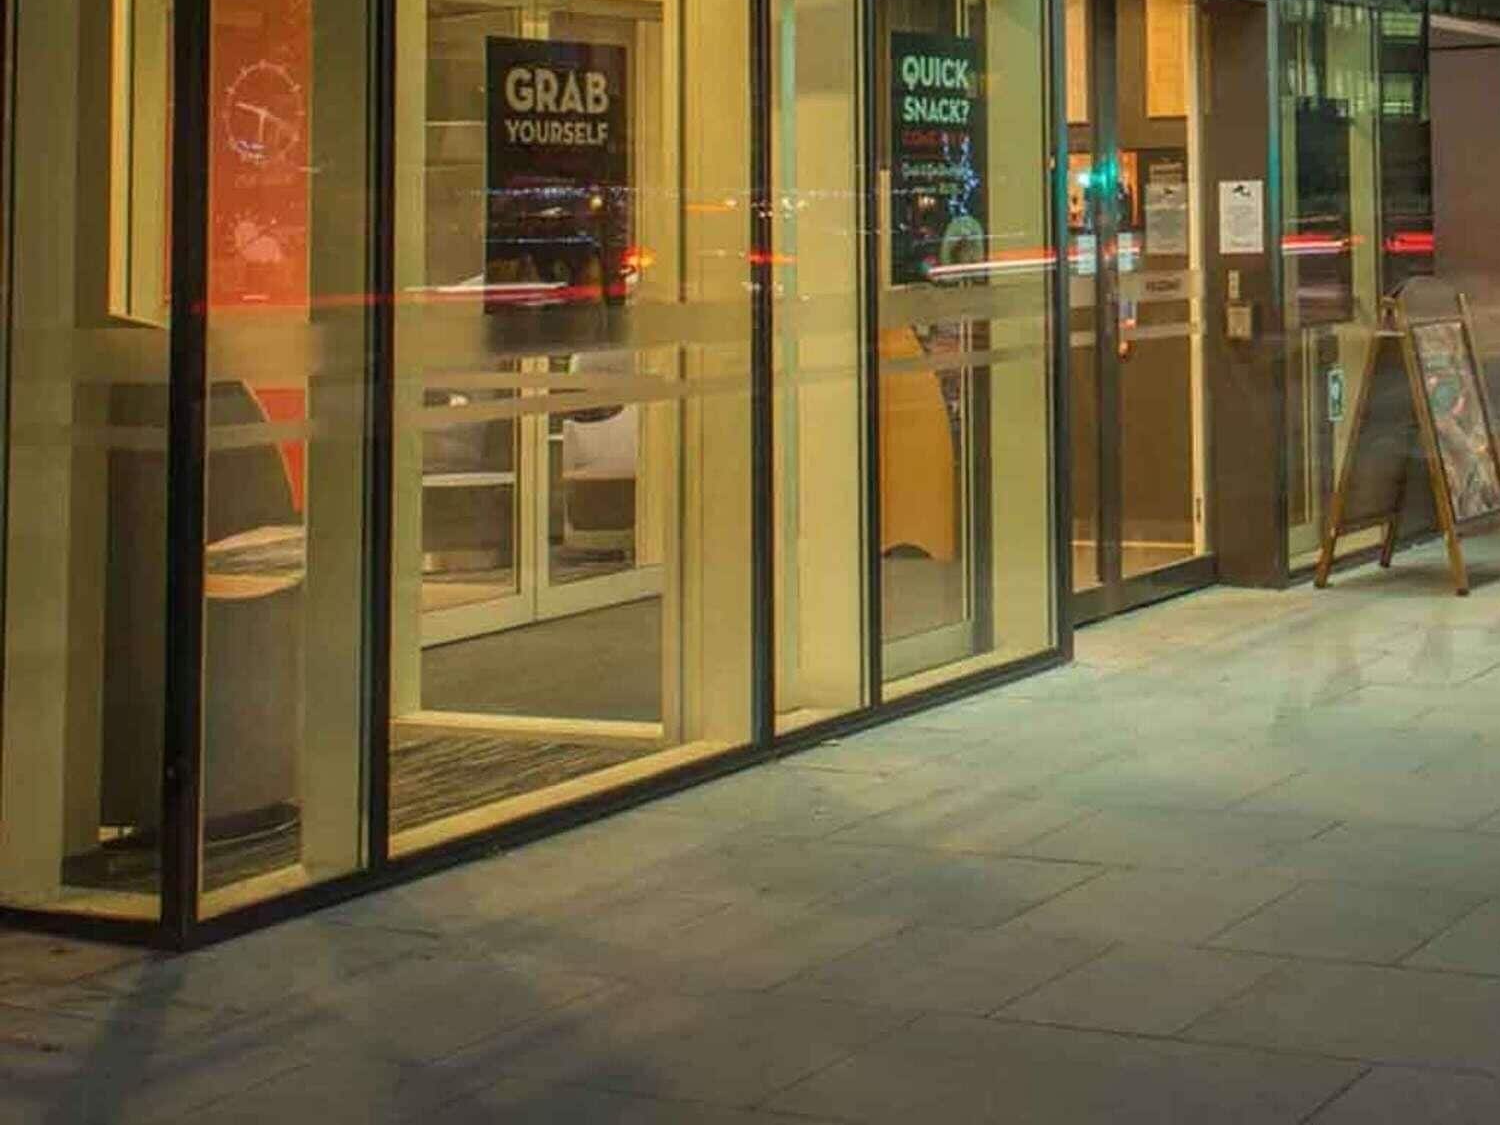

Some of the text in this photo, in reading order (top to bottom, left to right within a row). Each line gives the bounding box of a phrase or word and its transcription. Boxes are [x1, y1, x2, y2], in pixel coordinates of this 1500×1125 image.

[902, 56, 969, 89] QUICK
[505, 68, 609, 113] GRAB
[903, 96, 970, 123] SNACK?
[504, 120, 608, 145] YOURSELF
